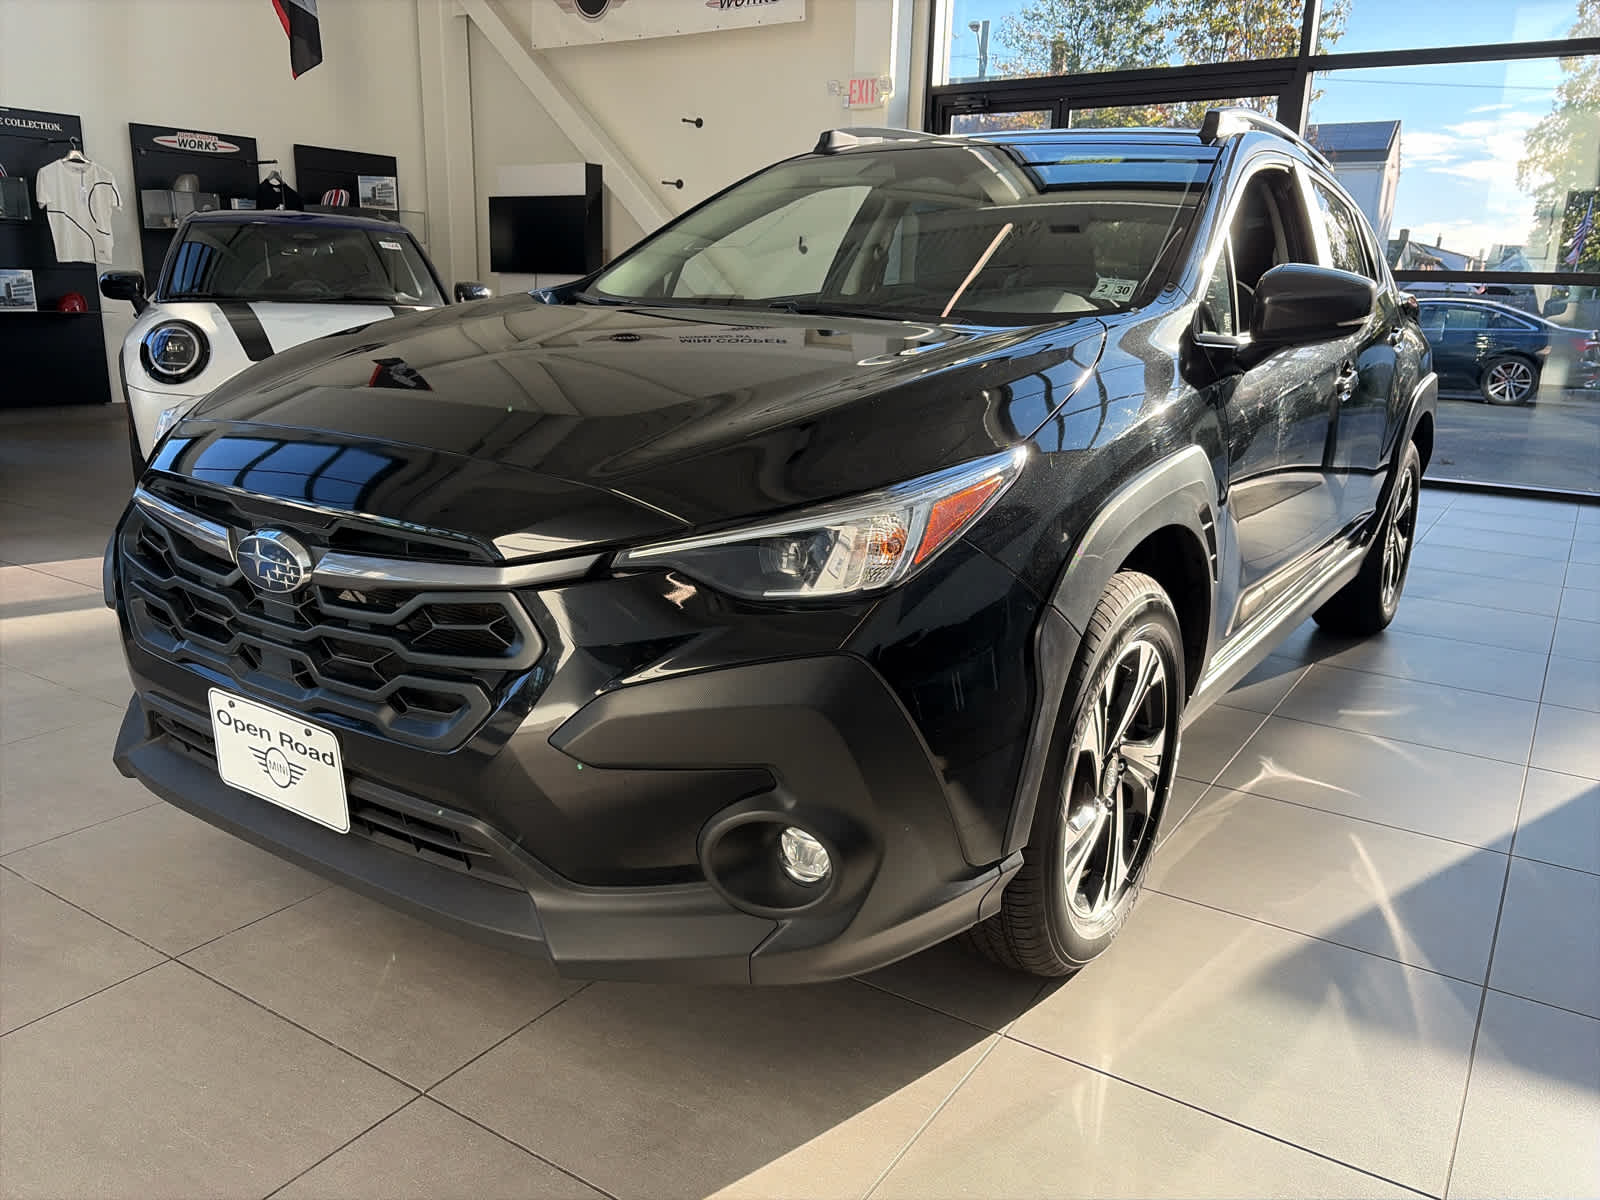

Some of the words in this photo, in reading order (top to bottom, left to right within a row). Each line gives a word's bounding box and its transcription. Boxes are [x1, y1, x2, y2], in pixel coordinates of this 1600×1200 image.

[849, 79, 877, 104] EXIT
[177, 138, 218, 151] WORKS
[1096, 284, 1108, 293] 2
[1114, 285, 1131, 295] 30
[216, 709, 272, 742] Open
[279, 731, 336, 768] Road
[268, 759, 289, 777] MINI
